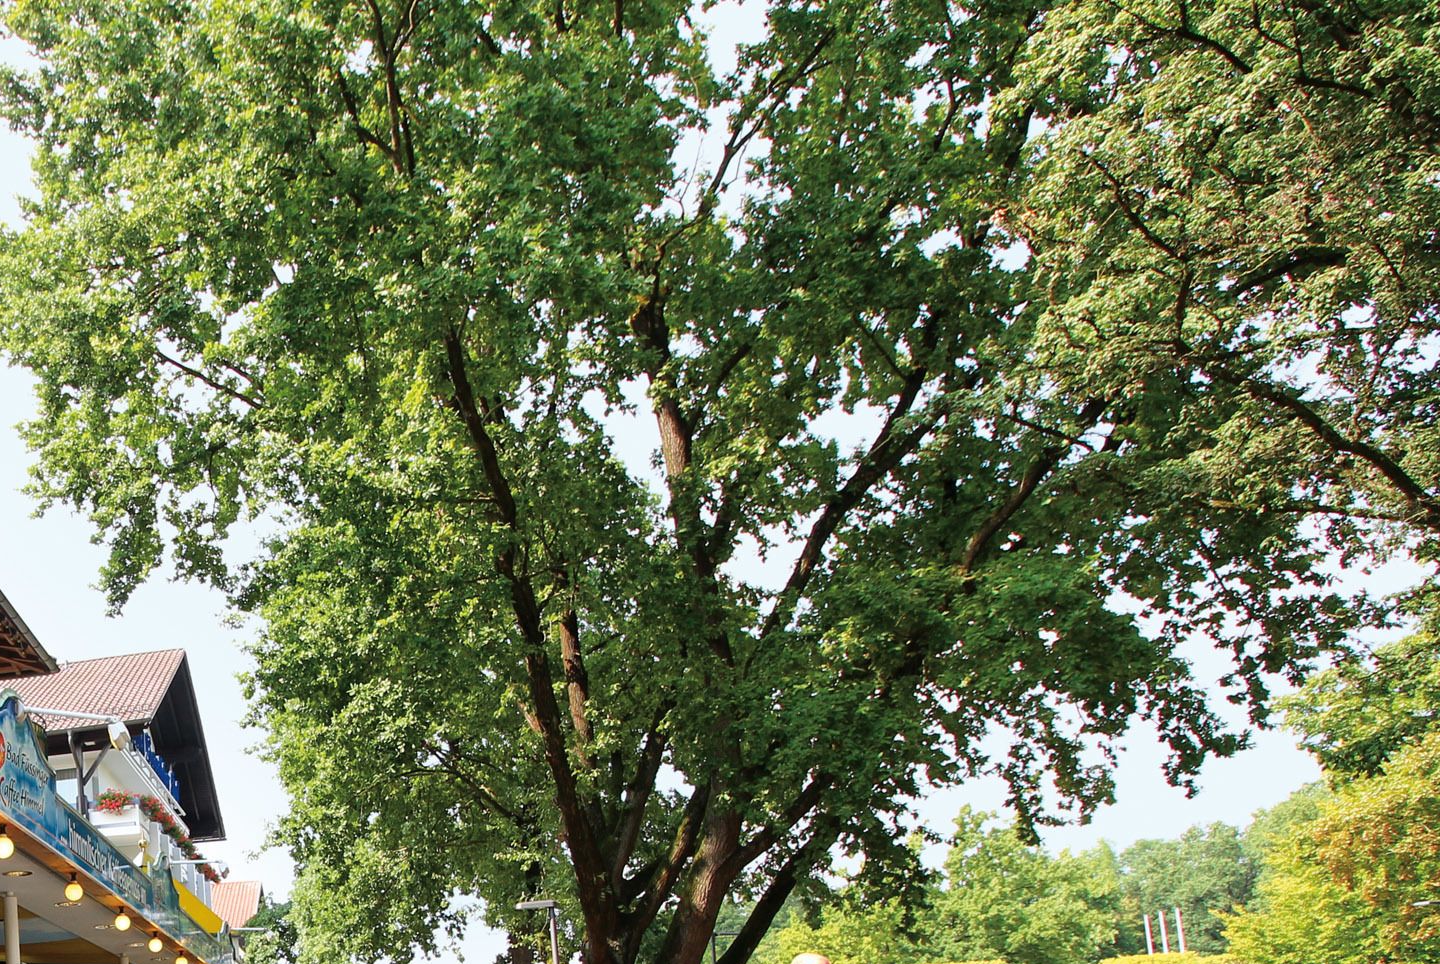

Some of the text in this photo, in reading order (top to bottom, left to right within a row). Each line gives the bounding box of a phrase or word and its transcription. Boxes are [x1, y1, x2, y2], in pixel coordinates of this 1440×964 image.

[6, 740, 49, 789] Bad Füssinger
[20, 787, 45, 816] Himmel
